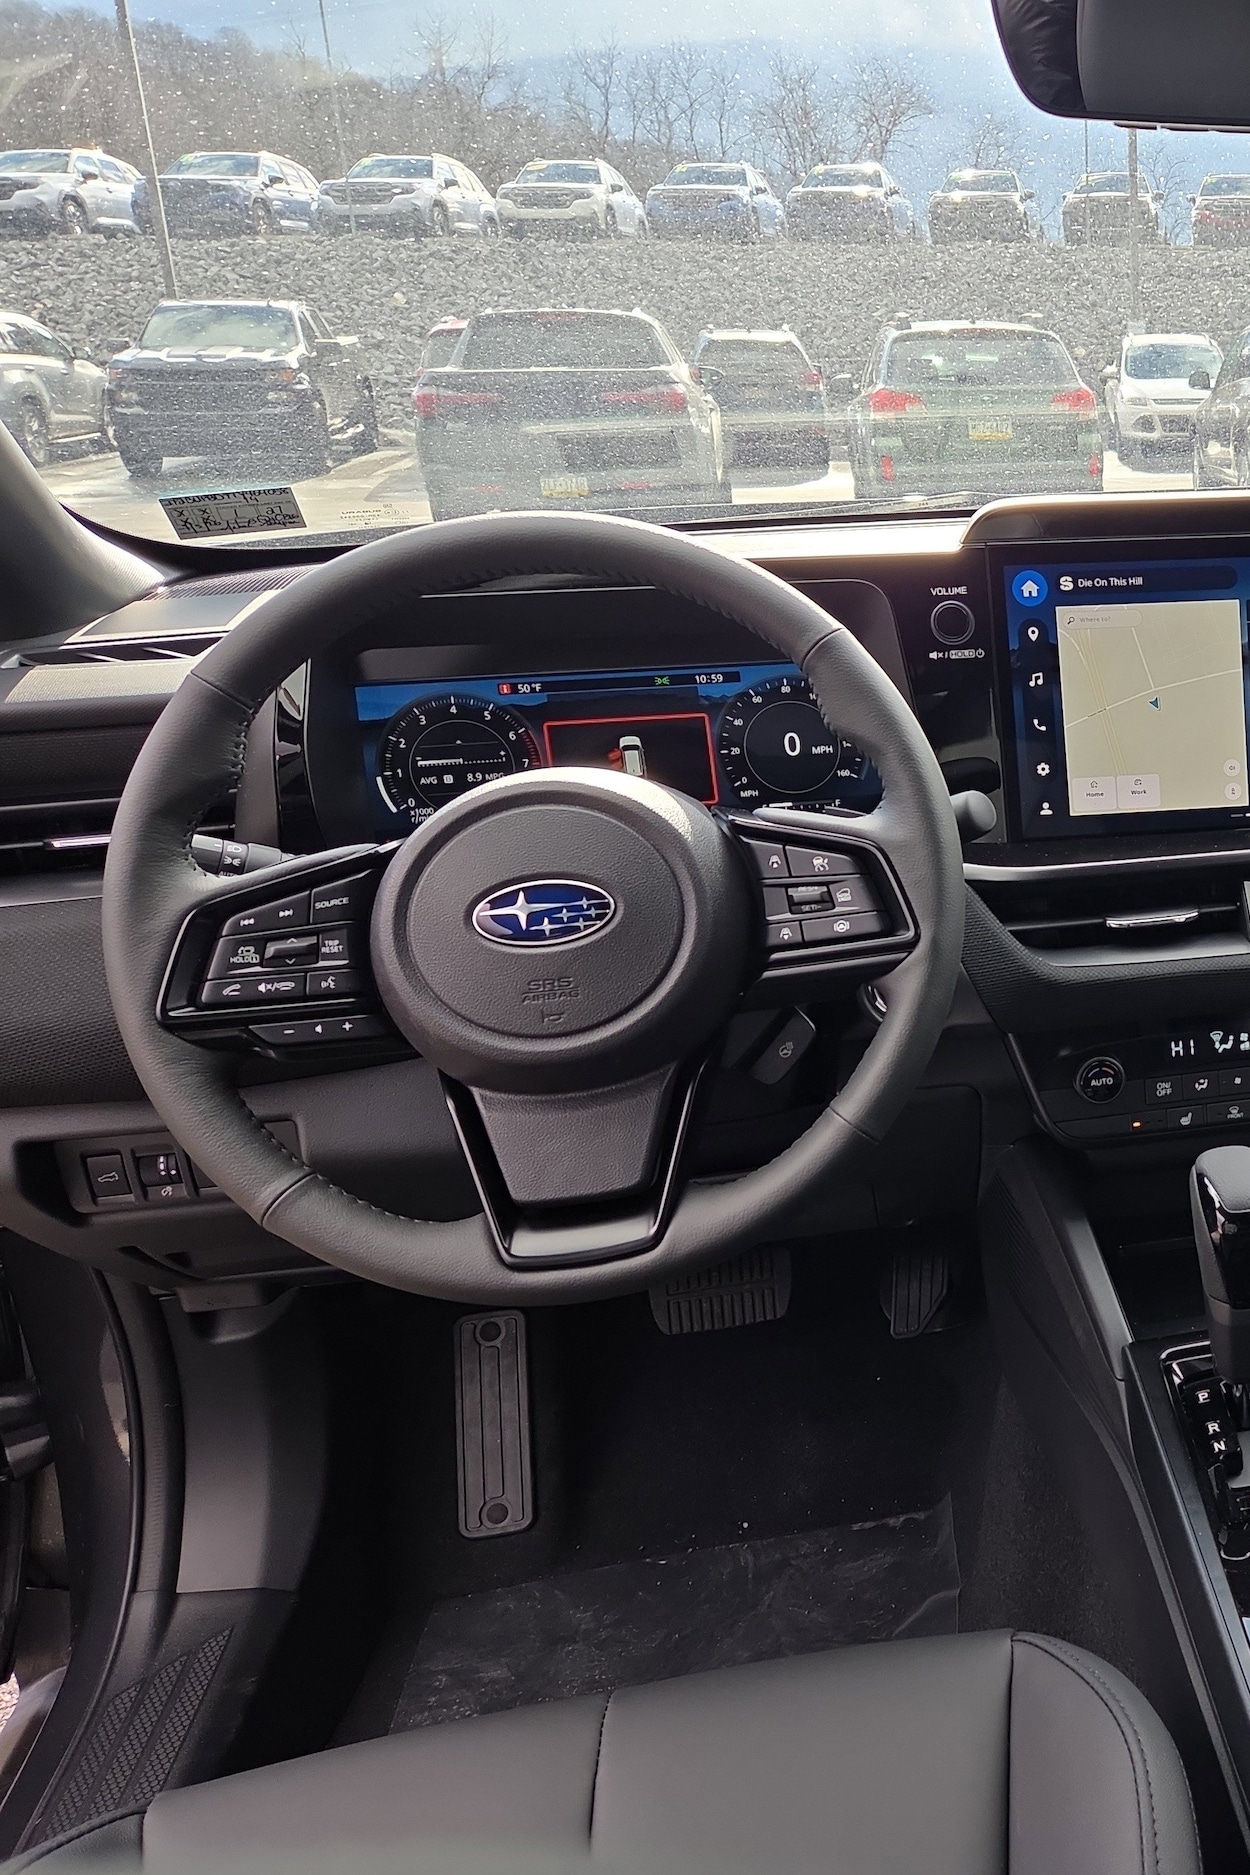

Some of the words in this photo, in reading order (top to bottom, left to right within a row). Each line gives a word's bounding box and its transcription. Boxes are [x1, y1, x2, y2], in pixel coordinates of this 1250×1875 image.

[1078, 578, 1093, 588] Die
[1094, 578, 1108, 587] On
[1109, 577, 1127, 586] This
[1128, 576, 1143, 586] Hill
[930, 586, 968, 596] VOLUME
[951, 650, 975, 658] HOLD
[695, 674, 723, 684] 10:59
[449, 705, 457, 714] 4
[419, 715, 426, 725] 3
[484, 711, 491, 720] 5
[509, 731, 516, 741] 6
[399, 739, 406, 748] 2
[784, 732, 801, 757] 0
[811, 745, 833, 754] MPH
[522, 758, 529, 768] 7
[397, 769, 402, 778] 1
[420, 776, 437, 785] AVG
[466, 773, 482, 782] 8.9
[408, 798, 415, 808] 0
[314, 897, 350, 910] SOURCE
[321, 945, 344, 954] RESET
[528, 977, 574, 992] SRS
[521, 990, 580, 1005] AIRBAG
[1091, 1077, 1114, 1087] AUTO
[1156, 1081, 1172, 1090] ON/
[1156, 1088, 1173, 1097] OFF
[1198, 1392, 1210, 1404] P
[1207, 1423, 1220, 1435] R
[1213, 1441, 1226, 1453] N
